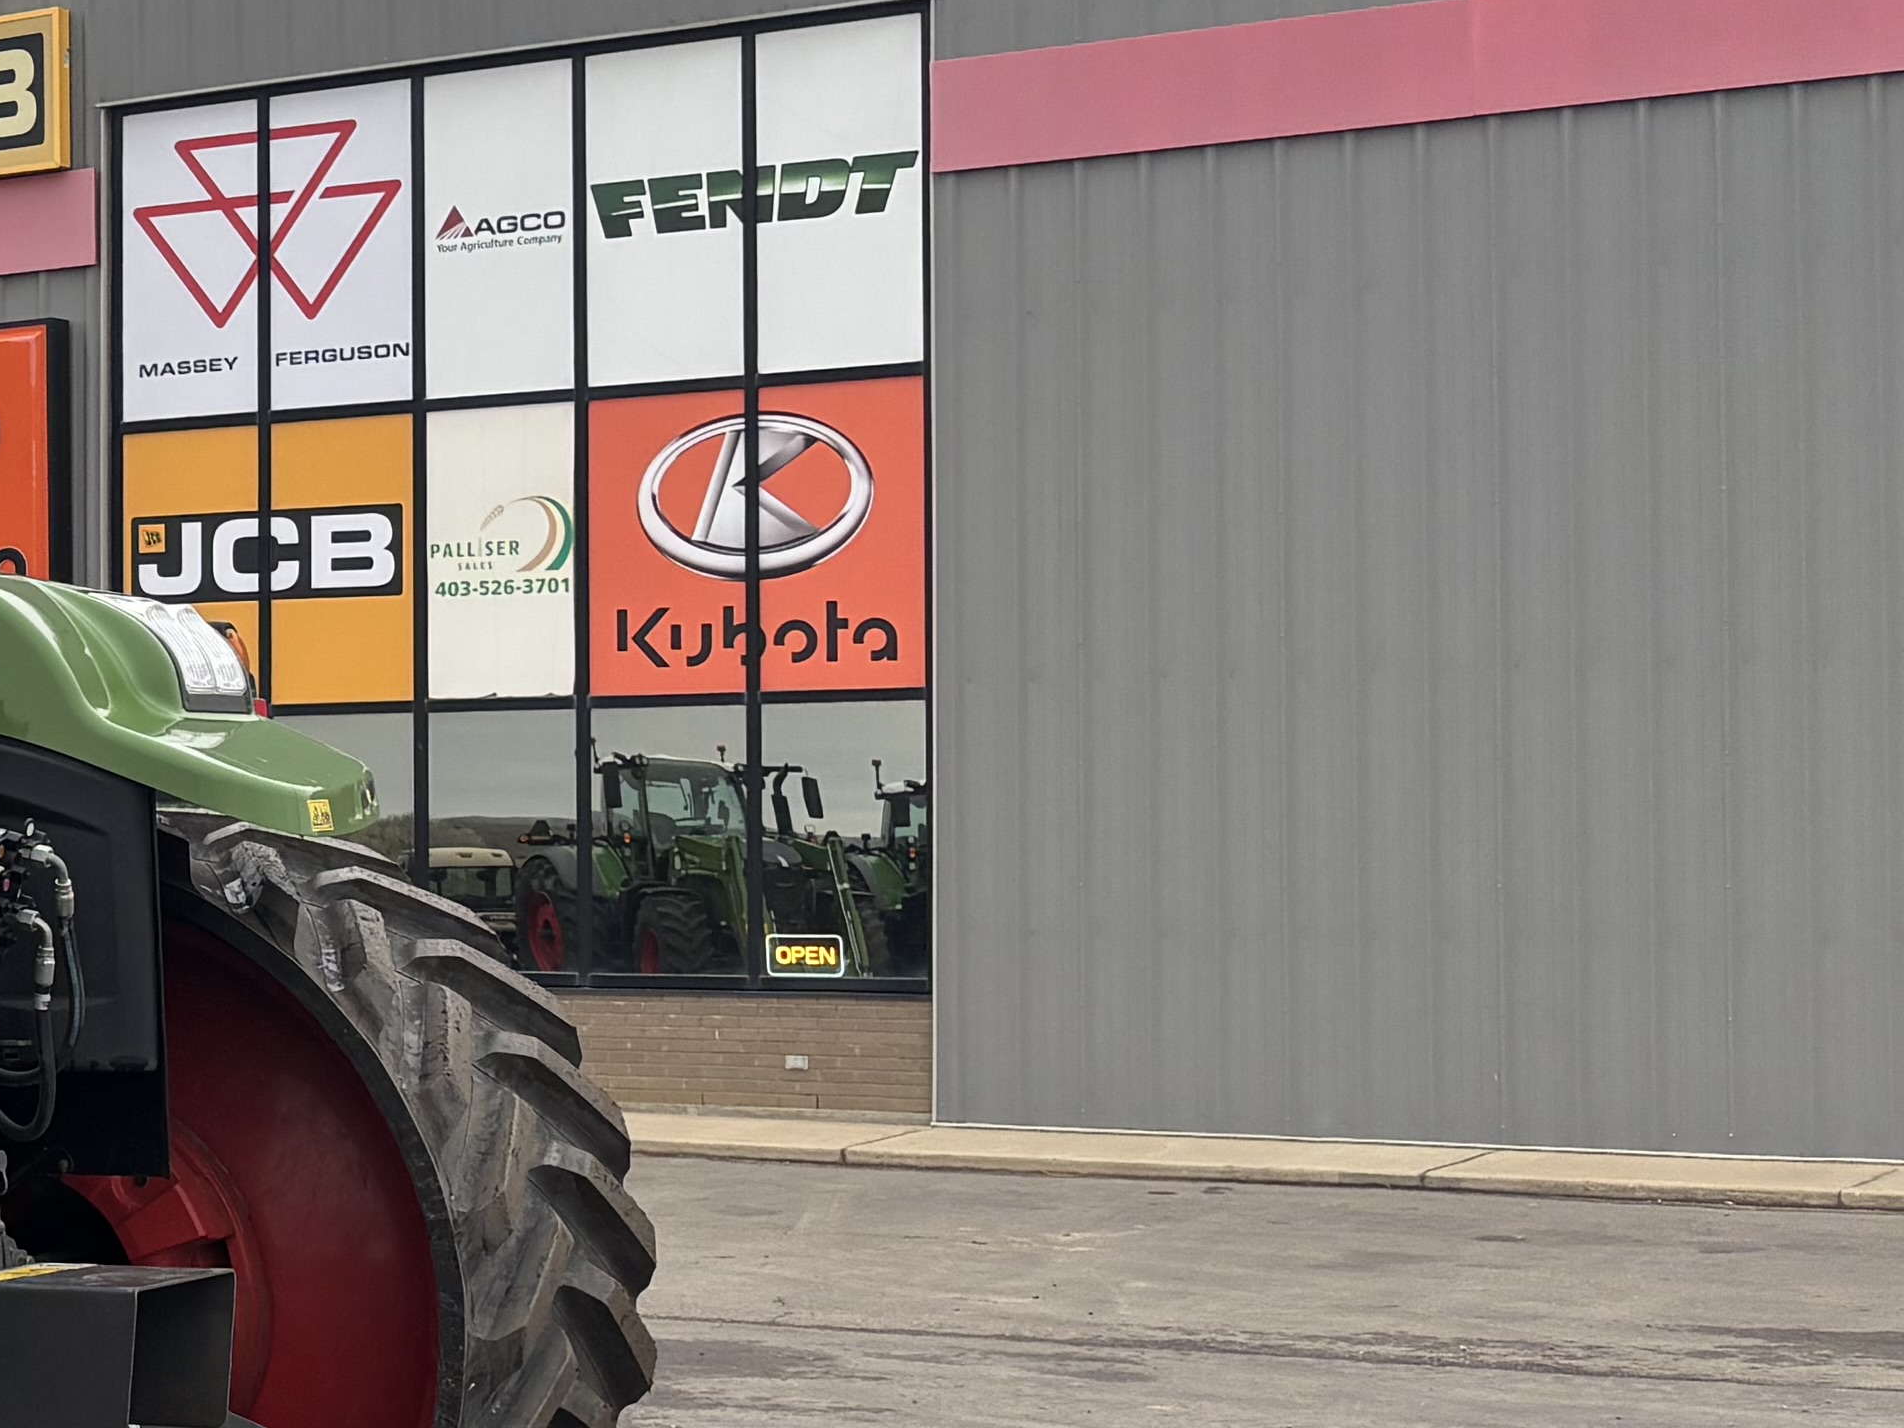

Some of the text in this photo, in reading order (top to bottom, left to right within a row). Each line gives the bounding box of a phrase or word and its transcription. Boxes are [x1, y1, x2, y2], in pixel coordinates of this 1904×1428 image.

[591, 150, 919, 239] FENDT
[475, 211, 565, 235] AGCO
[437, 234, 562, 253] Your Agriculture Company
[139, 342, 410, 378] MASSEY FERGUSON
[138, 513, 395, 595] JCB
[430, 538, 520, 559] PALLISER
[458, 561, 493, 571] SALES
[435, 577, 570, 597] 403-526-3701
[616, 600, 899, 668] Kubota
[775, 945, 837, 965] OPEN
